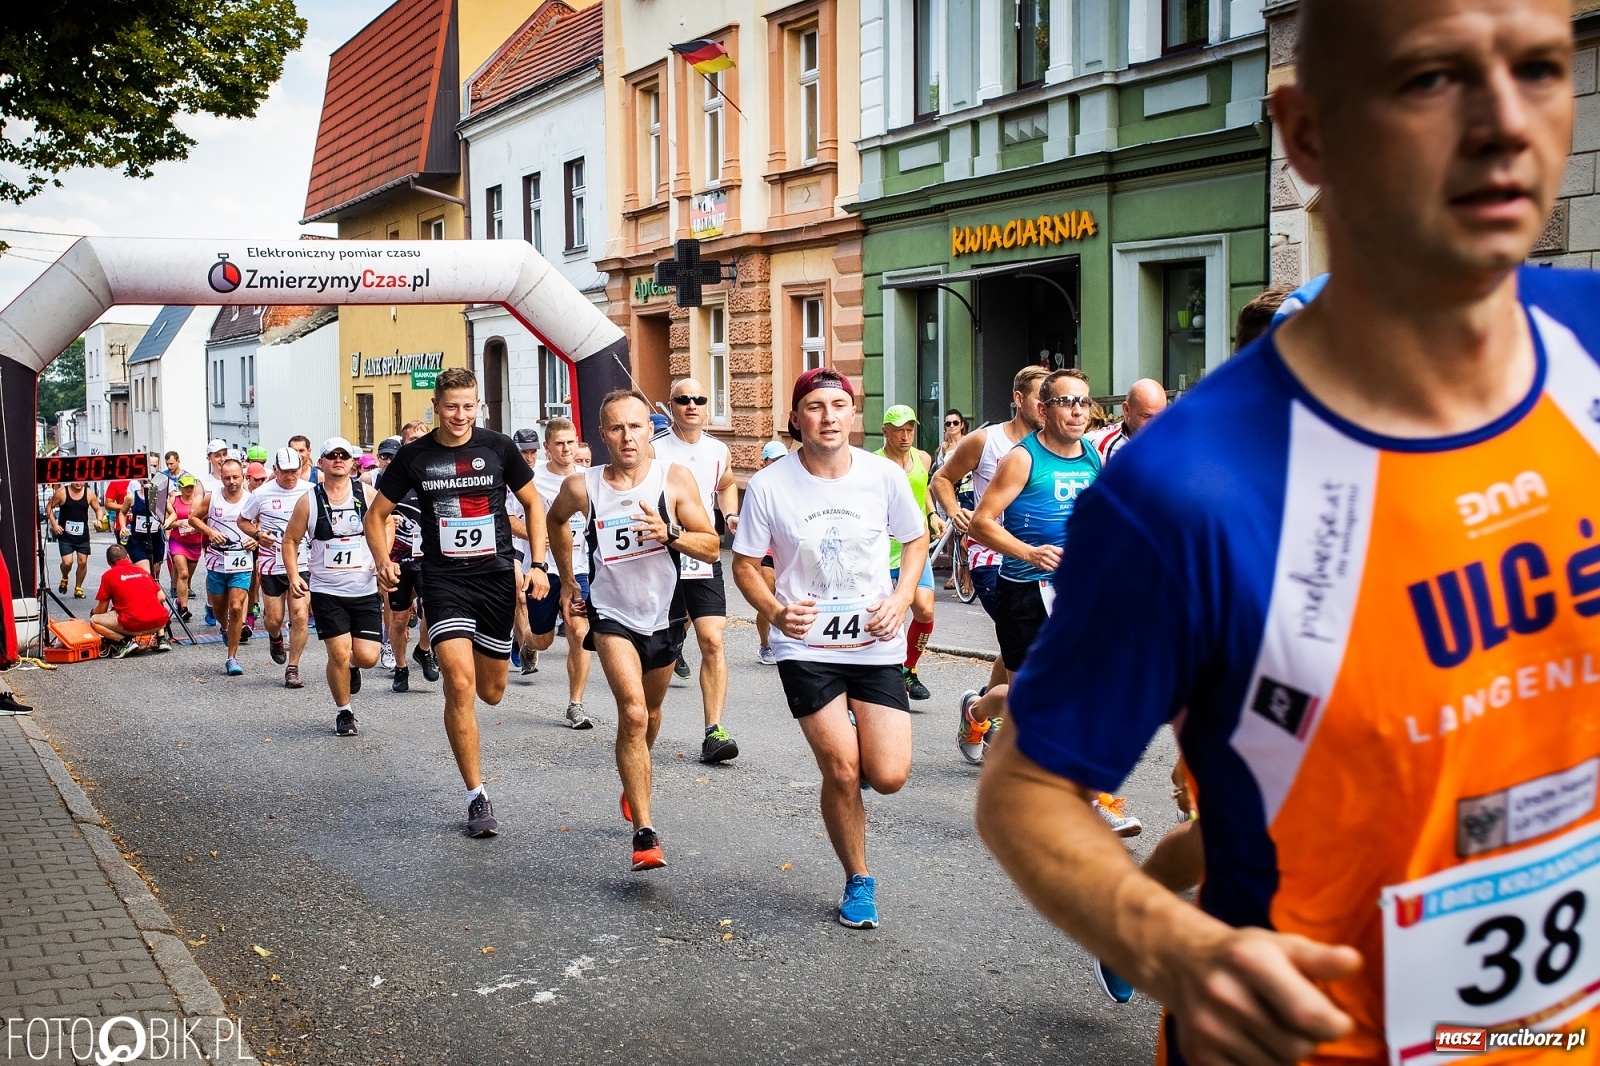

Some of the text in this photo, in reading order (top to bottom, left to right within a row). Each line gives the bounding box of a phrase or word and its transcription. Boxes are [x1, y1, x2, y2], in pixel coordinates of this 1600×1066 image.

[952, 209, 1097, 257] KWIACIARNIA
[247, 247, 421, 261] Elektroniczny pomiar czasu
[245, 268, 430, 294] ZmierzymyCzas.pl
[363, 349, 443, 377] BANK SPÓŁDZIELCZY
[46, 454, 146, 482] 0:00:05
[422, 474, 494, 491] RUNMAGEDDON
[453, 528, 483, 548] 59
[615, 527, 644, 551] 51
[231, 556, 247, 567] 46
[332, 550, 352, 565] 41
[680, 556, 700, 571] 45
[1407, 542, 1558, 669] ULC
[822, 613, 861, 641] 44
[1457, 890, 1586, 1007] 38
